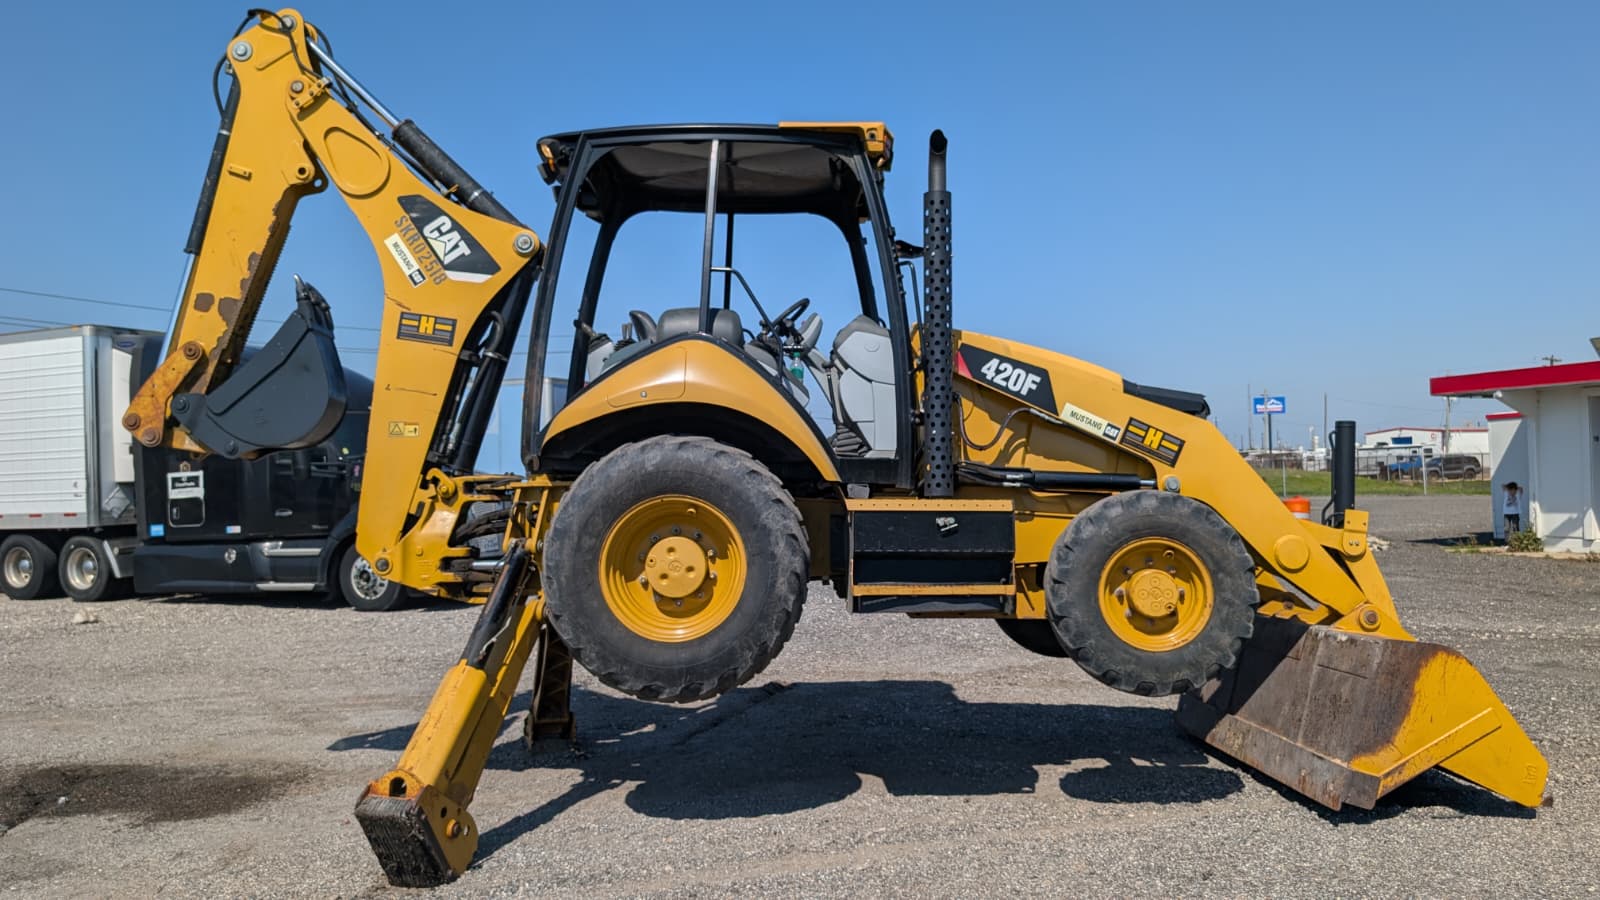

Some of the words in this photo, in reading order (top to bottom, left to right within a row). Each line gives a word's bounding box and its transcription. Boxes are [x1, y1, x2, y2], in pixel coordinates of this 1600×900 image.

[423, 215, 471, 265] CAT
[392, 241, 414, 270] MUSTANG
[419, 316, 435, 335] H
[981, 358, 1041, 396] 420F
[1069, 410, 1102, 430] MUSTANG
[1143, 427, 1164, 450] H
